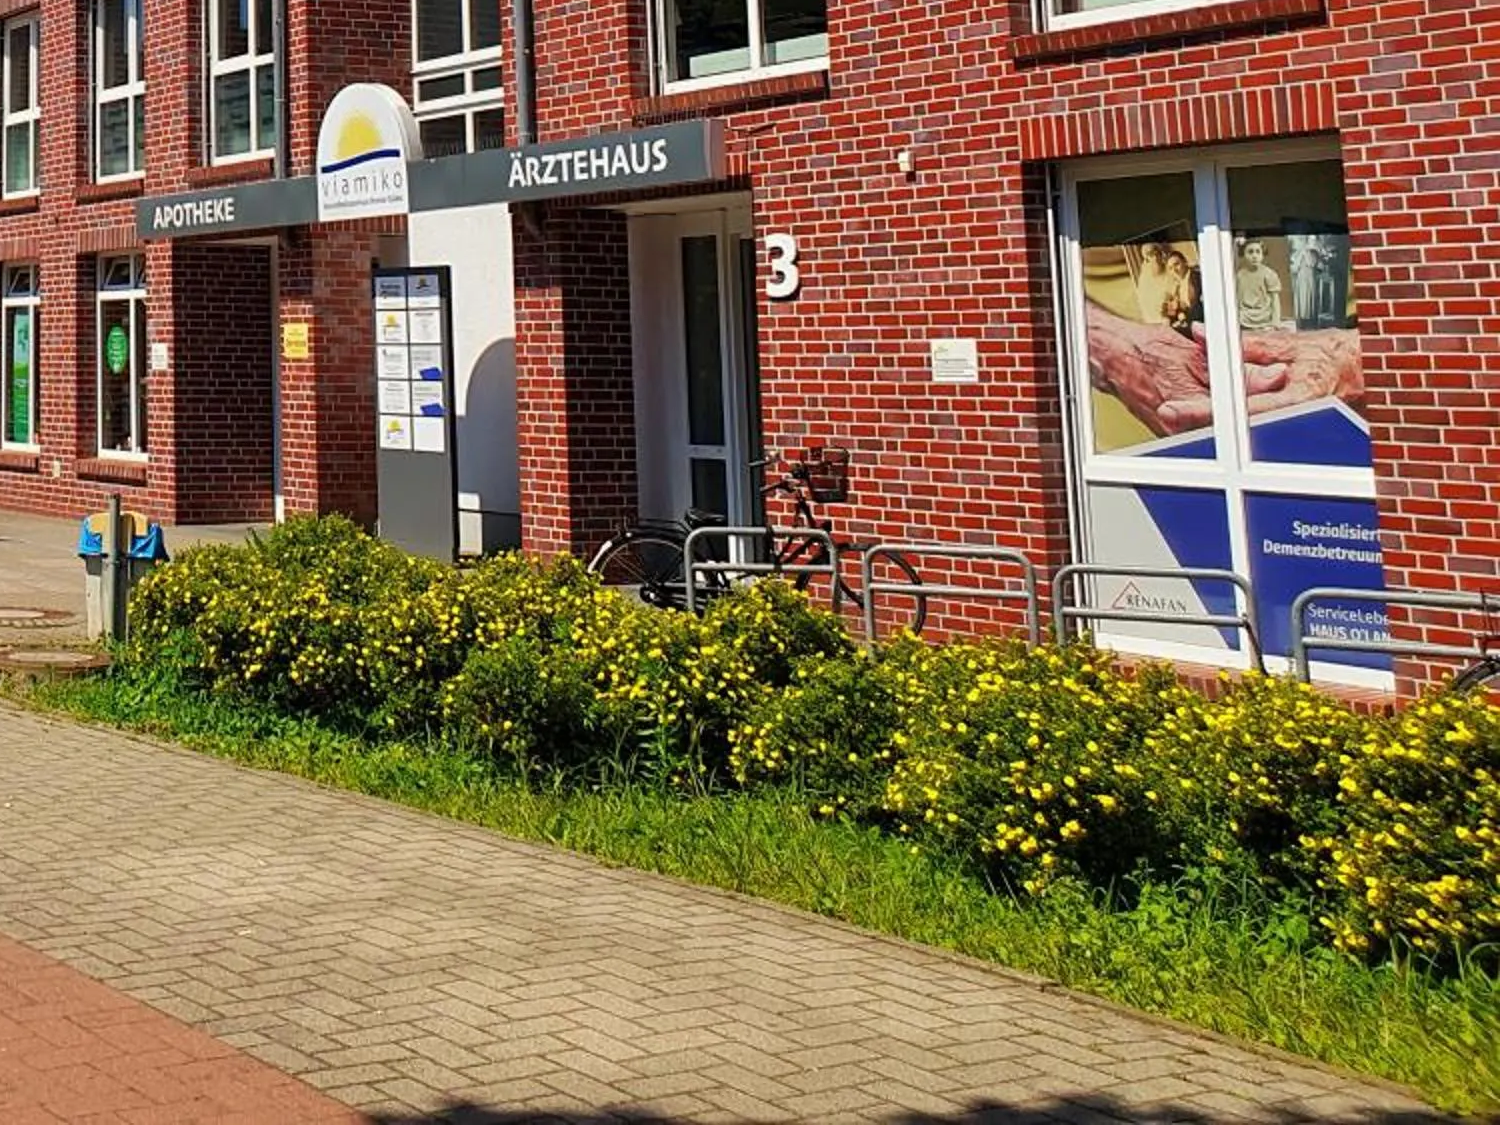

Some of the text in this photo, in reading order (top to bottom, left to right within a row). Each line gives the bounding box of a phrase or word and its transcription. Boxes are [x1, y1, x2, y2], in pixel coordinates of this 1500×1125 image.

[508, 137, 668, 188] ÄRZTEHAUS
[153, 197, 235, 229] APOTHEKE
[764, 233, 799, 297] 3
[1126, 594, 1187, 614] RENAFAN
[1309, 622, 1347, 639] HAUS
